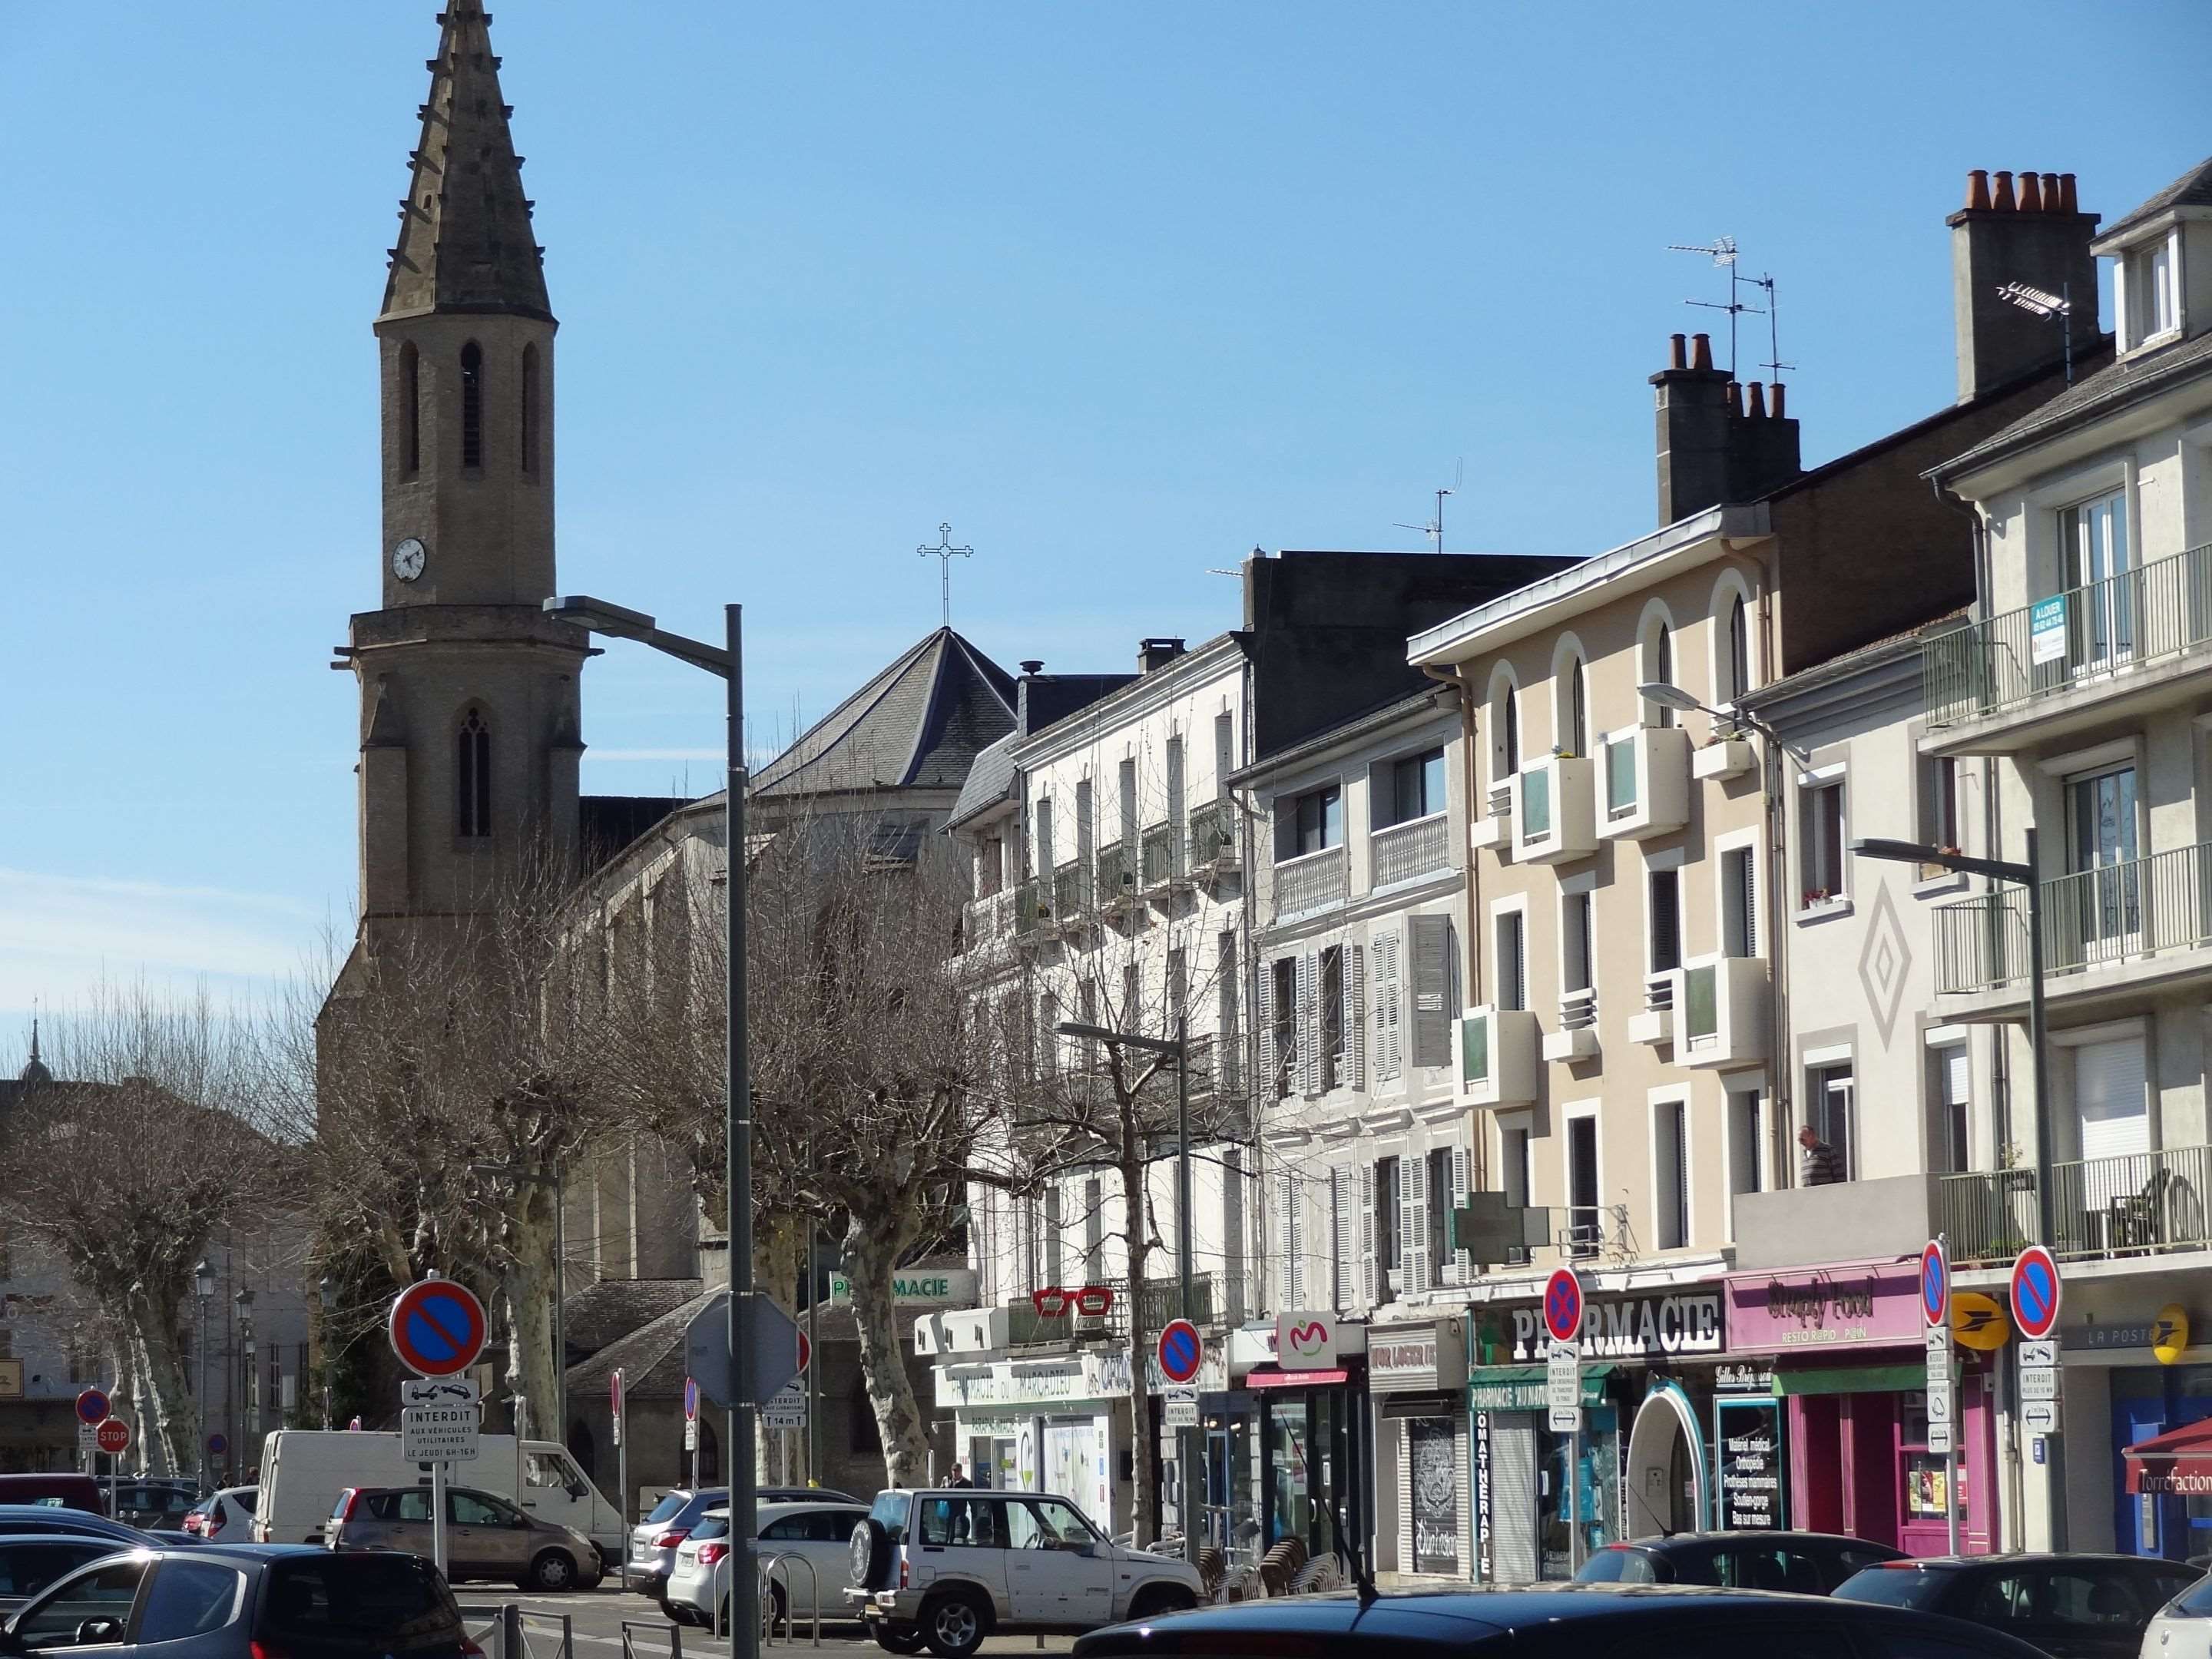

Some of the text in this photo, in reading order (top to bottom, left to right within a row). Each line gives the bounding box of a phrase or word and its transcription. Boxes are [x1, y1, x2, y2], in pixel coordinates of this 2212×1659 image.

[833, 1278, 949, 1297] PMACIE
[1512, 1295, 1720, 1359] PHRMACIE
[1782, 1331, 1809, 1343] RESTO
[2088, 1331, 2104, 1344] LA
[1549, 1367, 1576, 1376] INTERDIT
[952, 1373, 994, 1399] PHARMACIE
[1020, 1369, 1071, 1399] MARCADIEU
[2023, 1374, 2051, 1383] INTERDIT
[1472, 1387, 1512, 1408] PHARMACIE
[410, 1411, 471, 1422] INTERDIT
[101, 1432, 127, 1442] STOP
[1732, 1510, 1743, 1525] Bas
